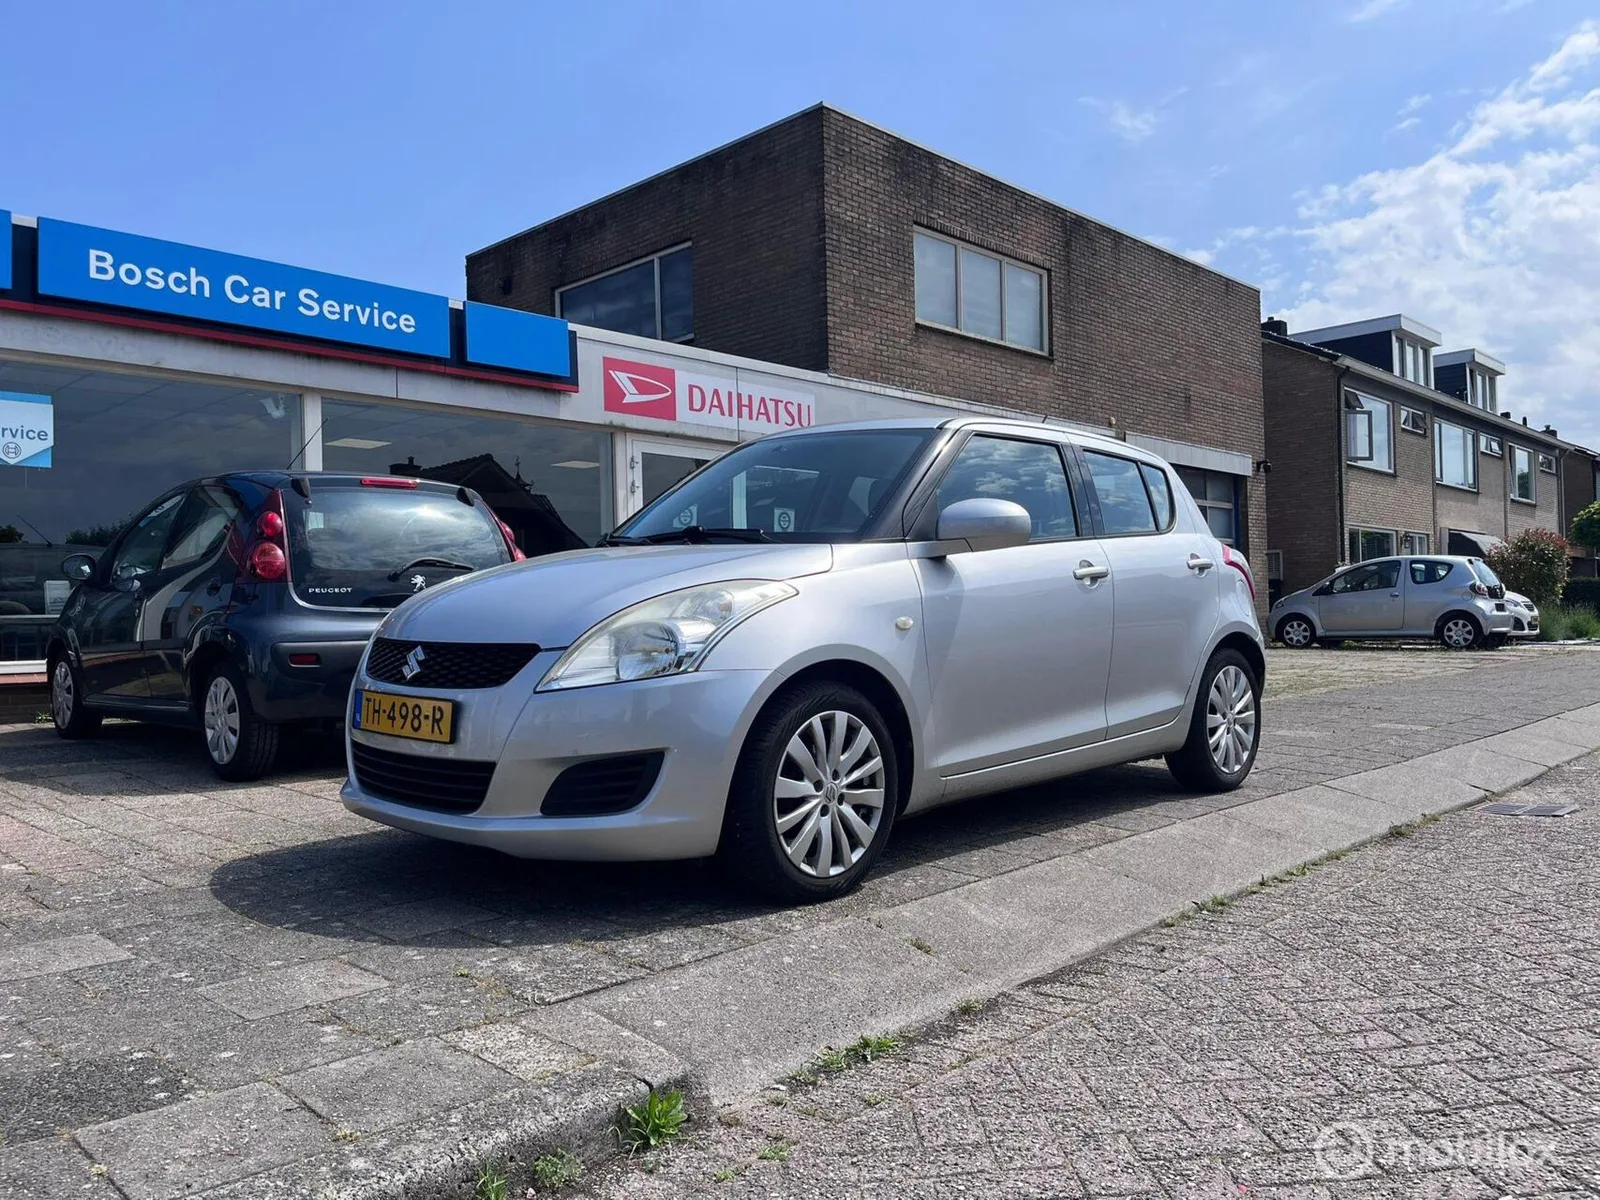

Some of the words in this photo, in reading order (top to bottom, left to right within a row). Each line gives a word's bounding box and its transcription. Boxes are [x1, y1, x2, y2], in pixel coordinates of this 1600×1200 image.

[89, 249, 210, 298] Bosch
[224, 274, 286, 310] Car
[298, 288, 416, 333] Service
[688, 383, 811, 428] DAIHATSU
[364, 696, 444, 735] TH-498-R
